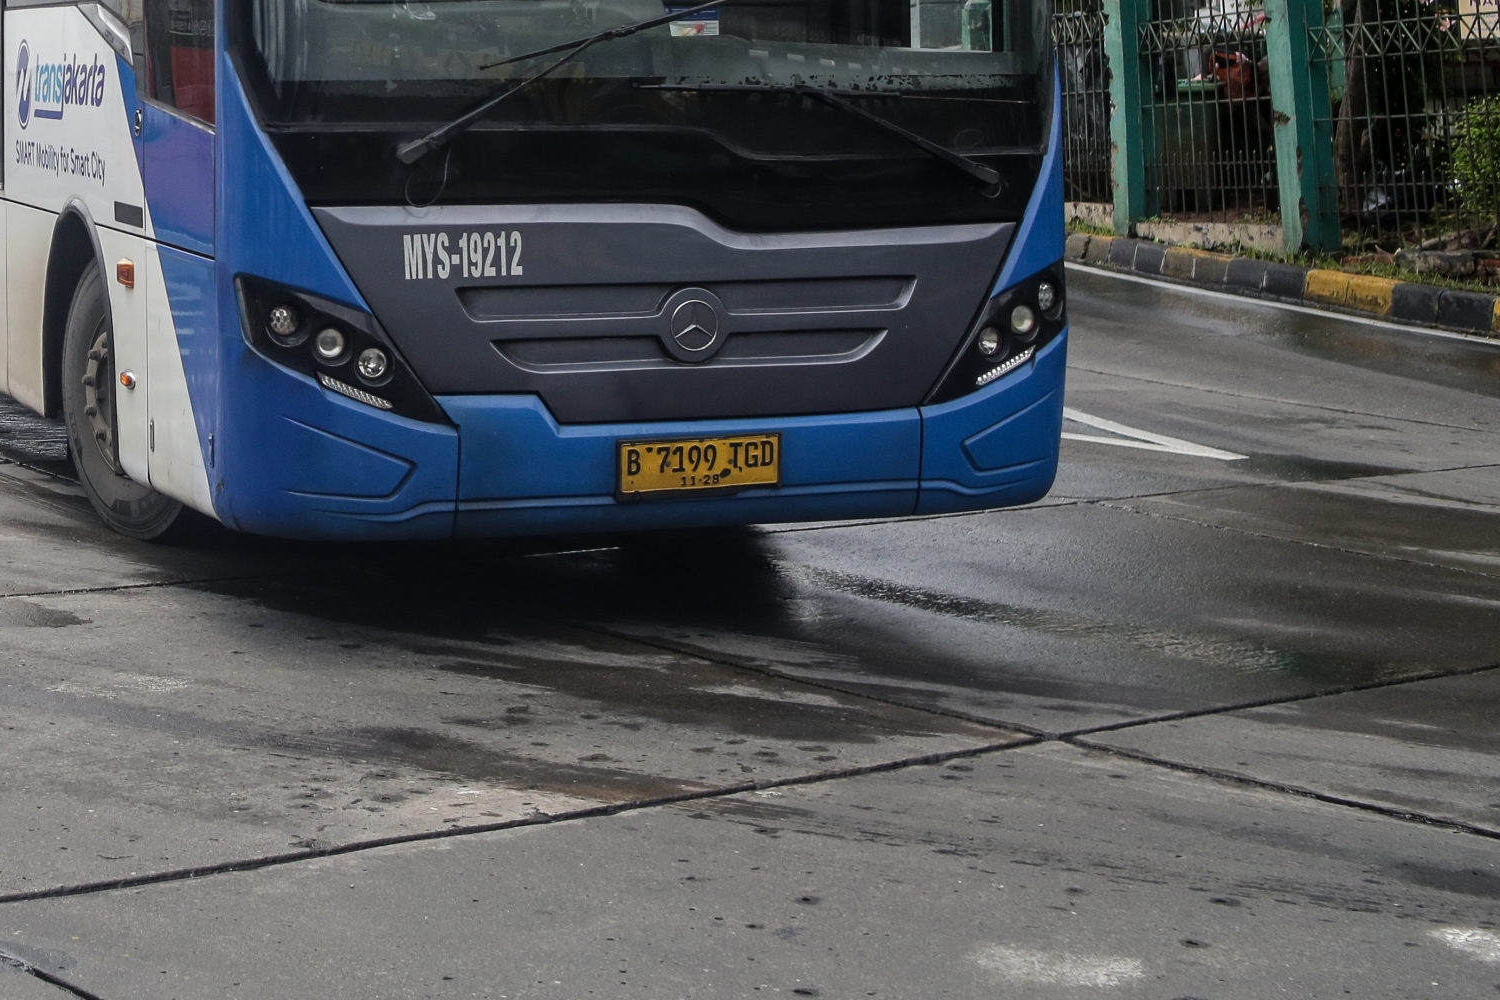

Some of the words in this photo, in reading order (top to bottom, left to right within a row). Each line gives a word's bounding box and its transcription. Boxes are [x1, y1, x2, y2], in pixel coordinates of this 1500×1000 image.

[34, 53, 106, 120] transjakarta
[15, 139, 35, 166] SMART
[36, 142, 60, 177] Mobility
[60, 145, 70, 174] for
[70, 147, 91, 178] Smart
[91, 151, 106, 188] City
[403, 231, 524, 280] MYS-19212
[627, 448, 641, 476] B
[656, 444, 718, 474] 7199
[729, 440, 775, 469] TGD
